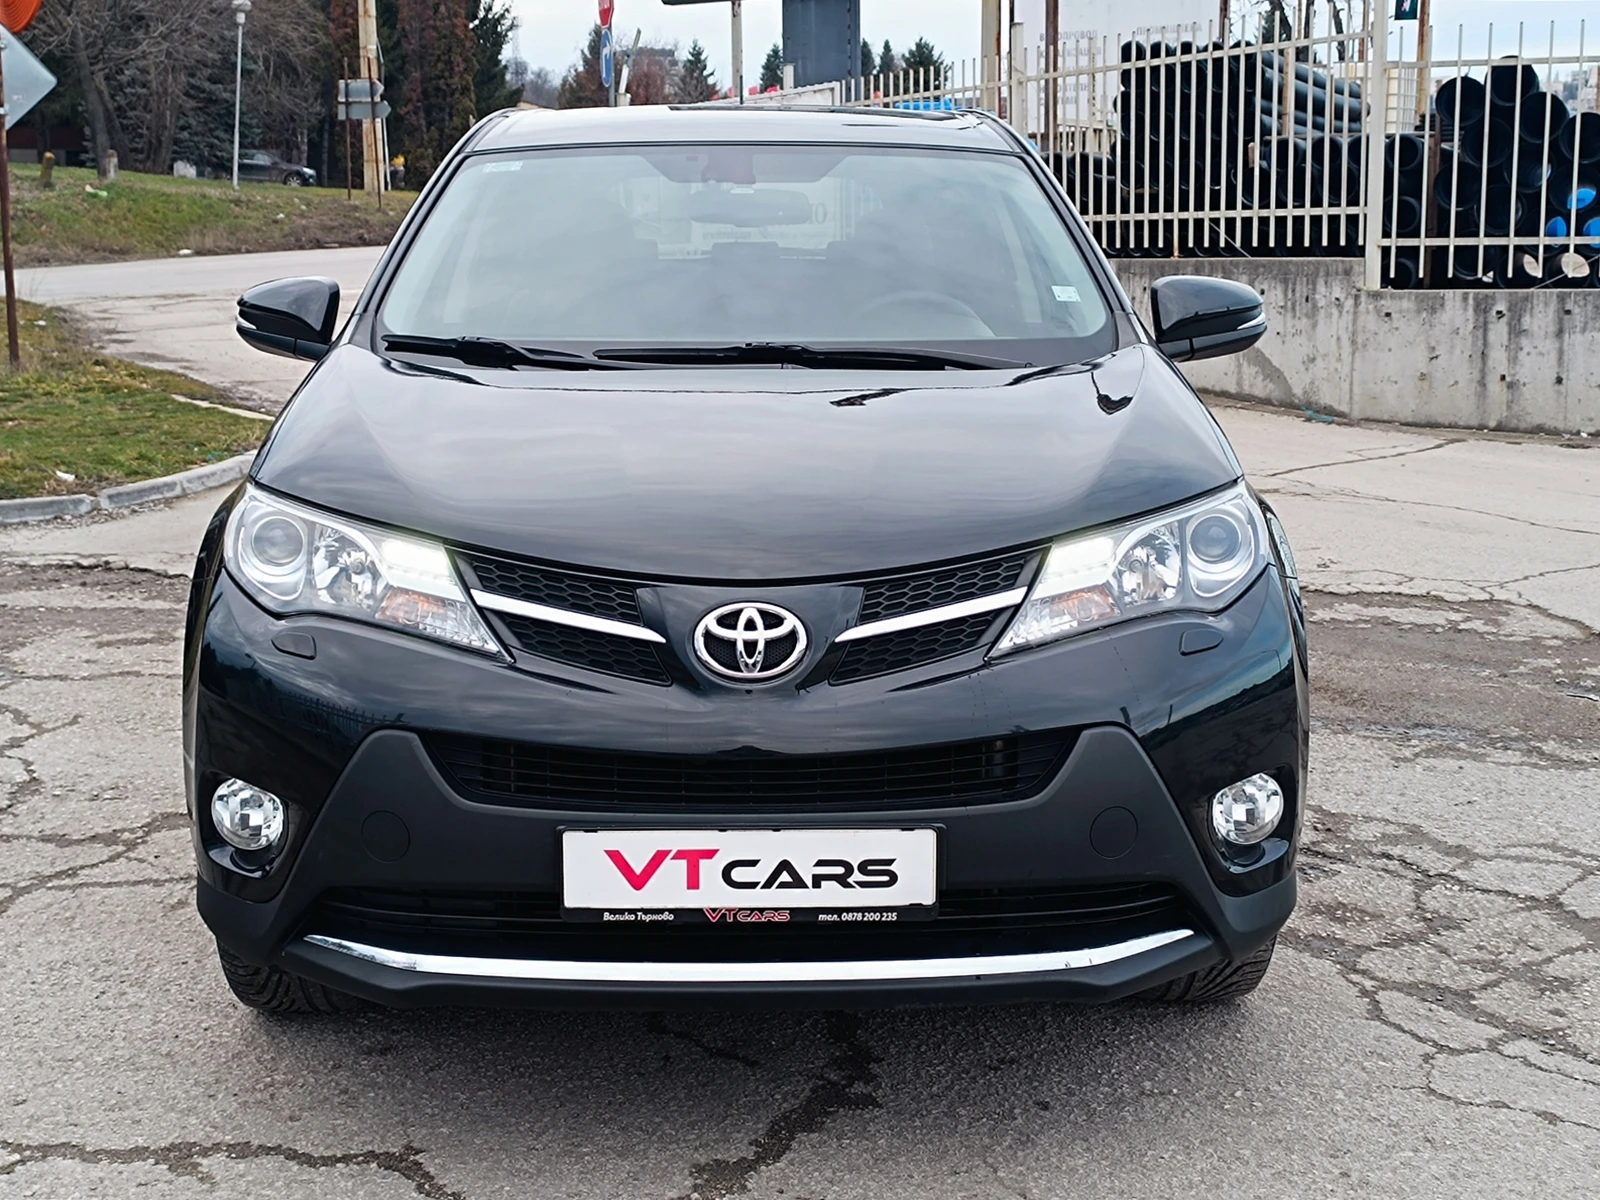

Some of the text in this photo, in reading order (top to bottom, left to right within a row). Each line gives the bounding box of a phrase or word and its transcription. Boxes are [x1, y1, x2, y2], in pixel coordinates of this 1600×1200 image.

[603, 849, 898, 891] VT CARS
[603, 912, 674, 922] Велико Търново
[841, 912, 862, 922] 0878
[864, 912, 880, 922] 200
[881, 912, 897, 922] 235
